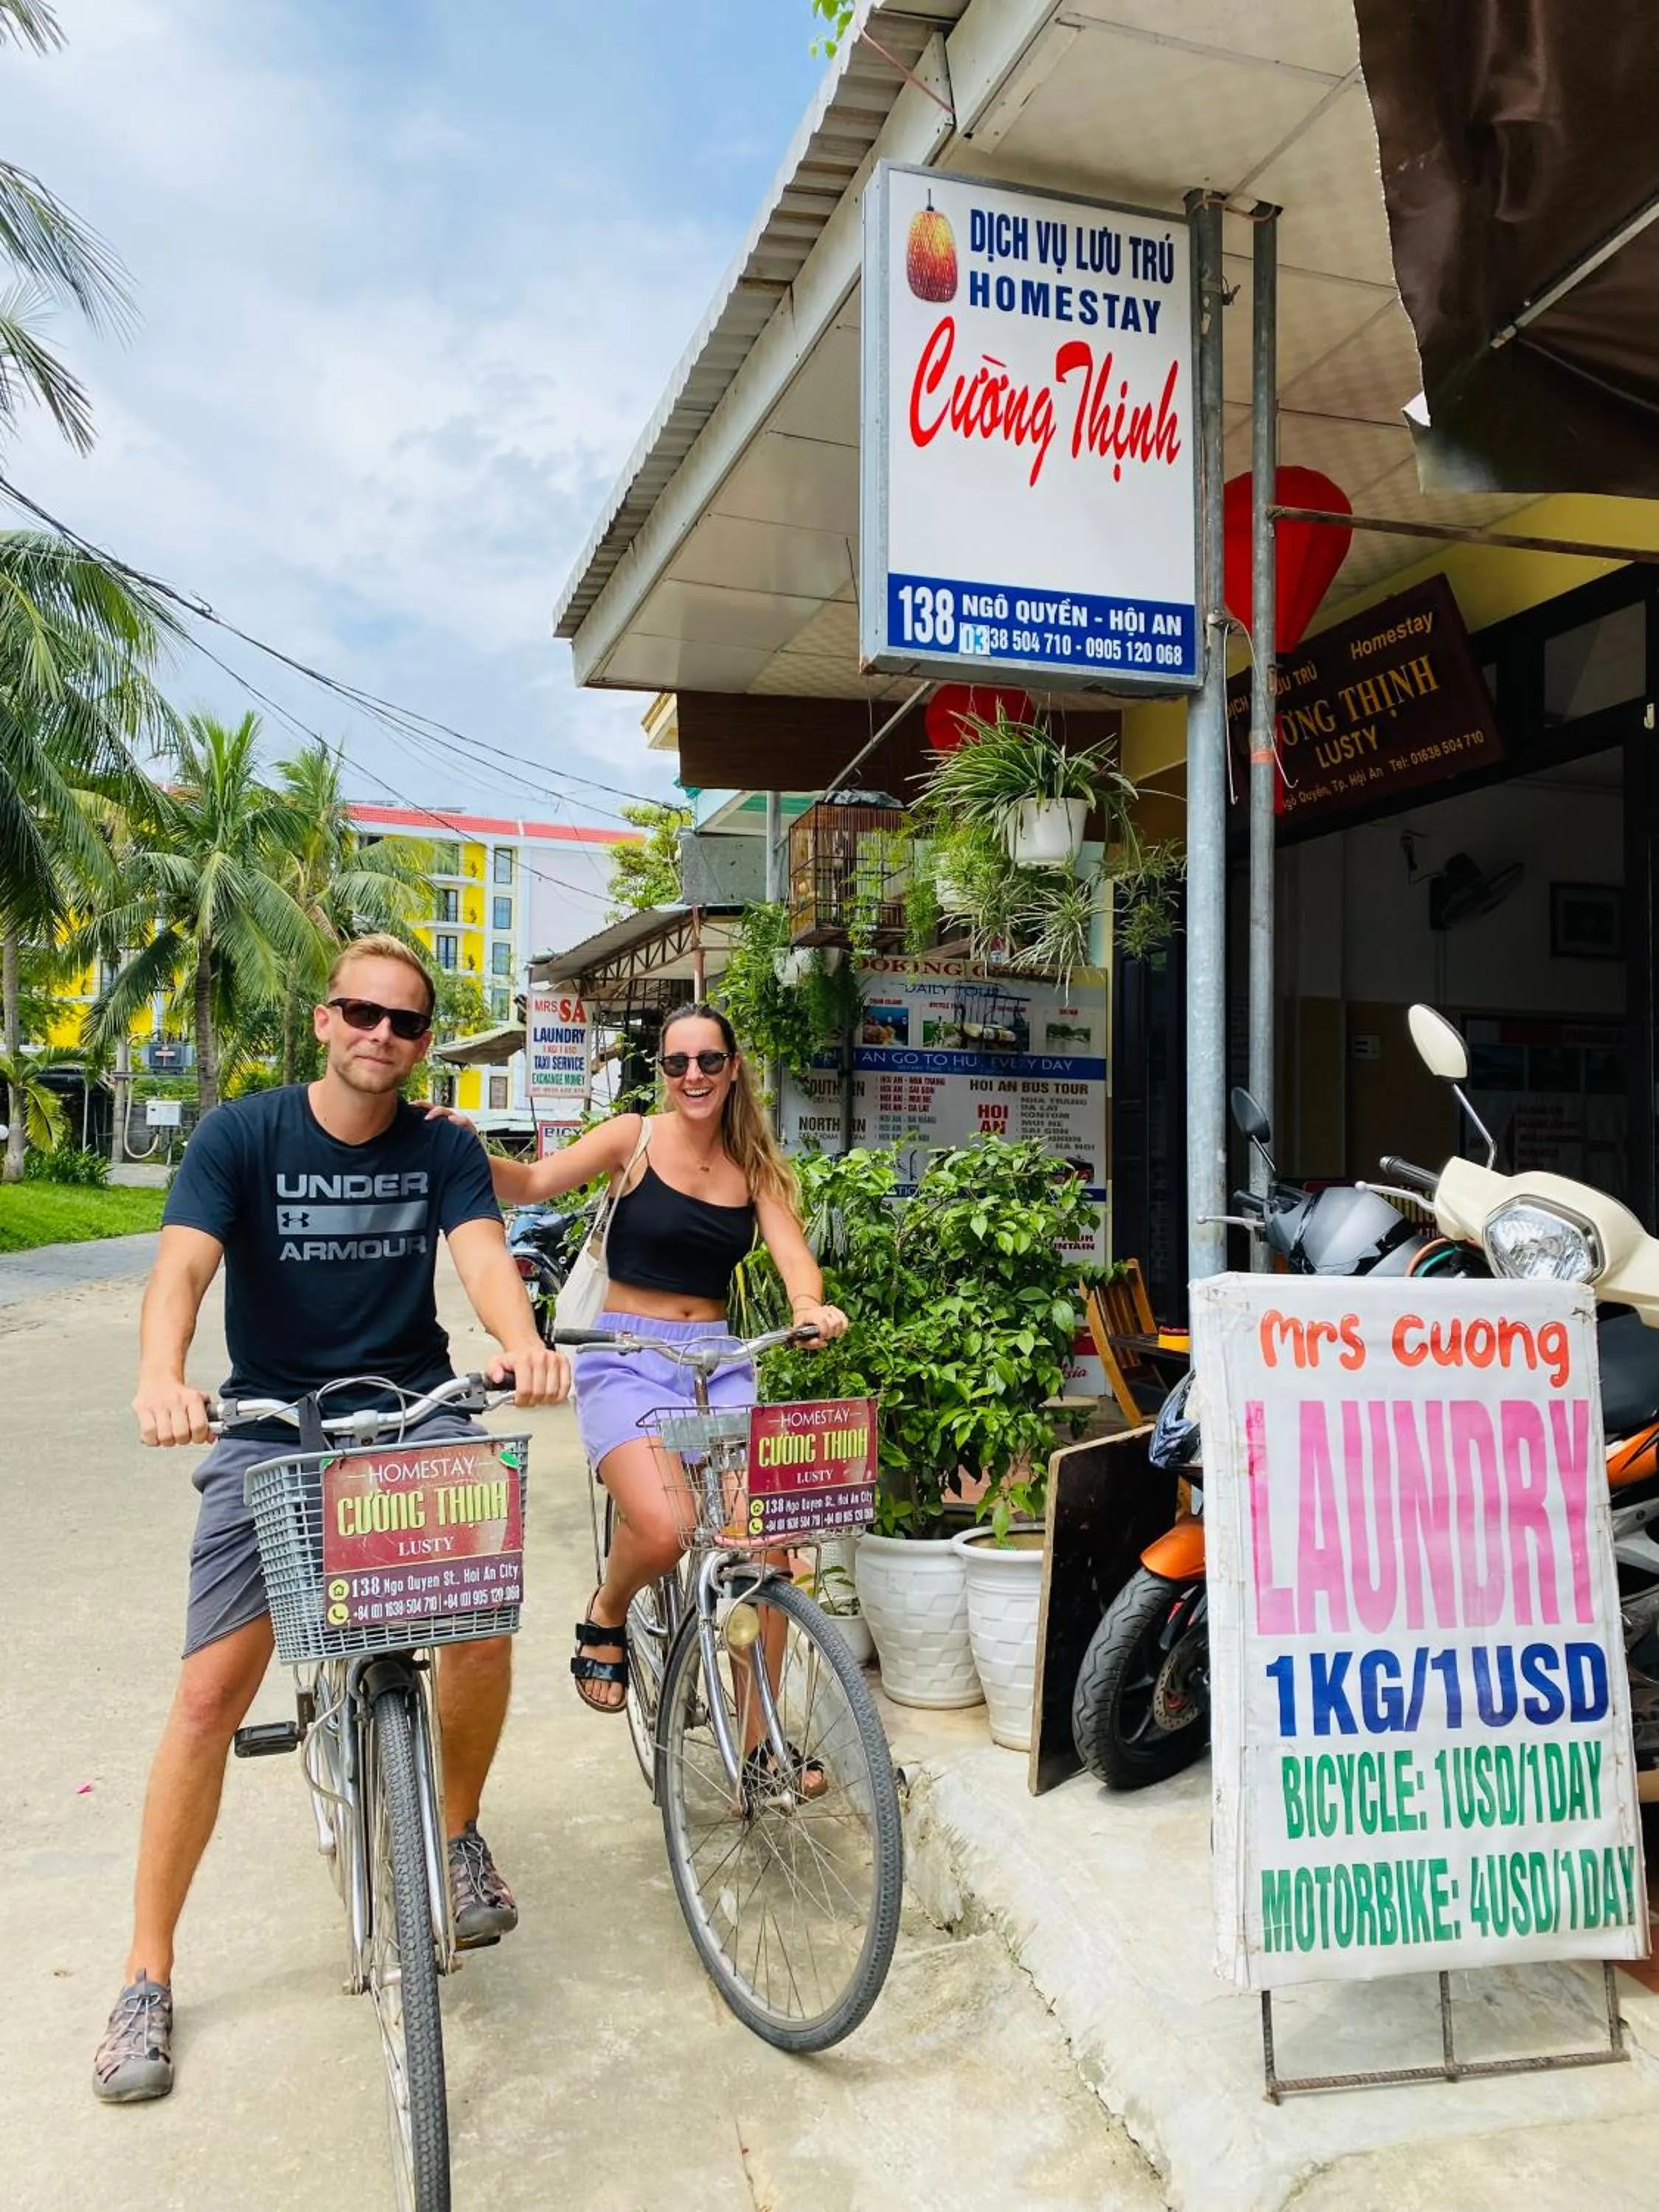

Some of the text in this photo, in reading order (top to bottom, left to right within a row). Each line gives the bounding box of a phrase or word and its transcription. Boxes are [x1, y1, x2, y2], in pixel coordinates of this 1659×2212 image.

[970, 209, 1175, 285] DỊCH VỤ LƯU TRÚ
[970, 271, 1161, 334] HOMESTAY
[908, 316, 1181, 487] Cường Thịnh
[899, 585, 955, 645] 138
[962, 594, 1009, 619] NGÔ
[1015, 598, 1088, 627] QUYỀN
[1110, 606, 1145, 636] HỘI
[1152, 616, 1182, 636] AN
[1012, 629, 1040, 653] 504
[1044, 633, 1071, 655] 710
[1086, 636, 1121, 659] 0905
[1126, 641, 1151, 663] 120
[1155, 644, 1182, 665] 068
[1350, 611, 1433, 660] Homestay
[1338, 655, 1441, 718] THỊNH
[1315, 725, 1378, 768] LUSTY
[1368, 767, 1384, 780] An
[1442, 737, 1464, 755] 504
[535, 997, 587, 1023] MRS SA
[533, 1027, 585, 1044] LAUNDRY
[535, 1055, 584, 1071] TAXI SERVICE
[862, 1051, 885, 1062] AN
[891, 1052, 919, 1064] GO
[922, 1054, 947, 1065] TO
[953, 1055, 977, 1067] HU
[1042, 1059, 1073, 1070] DAY
[970, 1079, 1088, 1095] HOI AN BUS TOUR
[978, 1104, 1009, 1119] HOI
[545, 1127, 582, 1138] BICY
[980, 1120, 1006, 1135] AN
[276, 1172, 428, 1199] UNDER
[279, 1235, 427, 1261] ARMOUR
[780, 1408, 849, 1427] HOMESTAY
[369, 1457, 474, 1484] HOMESTAY
[796, 1469, 833, 1484] LUSTY
[765, 1498, 784, 1514] 138
[1245, 1399, 1596, 1635] LAUNDRY
[398, 1537, 454, 1557] LUSTY
[352, 1576, 380, 1598] 138
[383, 1578, 403, 1596] Ngo
[408, 1575, 439, 1592] Quyen
[464, 1568, 479, 1583] Hoi
[483, 1566, 495, 1581] An
[499, 1562, 518, 1579] City
[406, 1597, 422, 1614] 504
[1281, 1741, 1602, 1840] BICYCLE: 1USD/1DAY
[1261, 1846, 1636, 1953] MOTORBIKE: 4USD/1DAY
